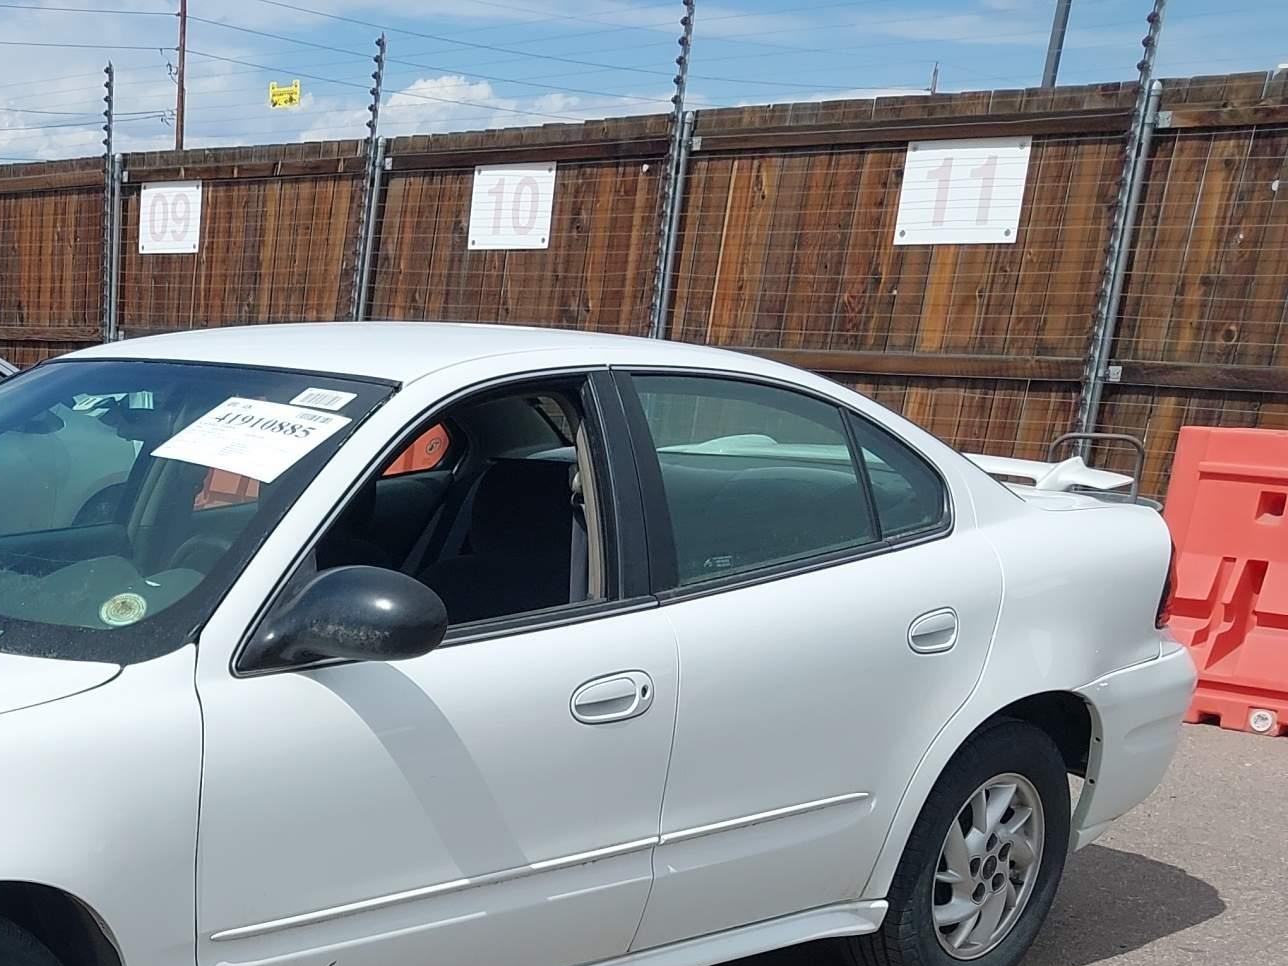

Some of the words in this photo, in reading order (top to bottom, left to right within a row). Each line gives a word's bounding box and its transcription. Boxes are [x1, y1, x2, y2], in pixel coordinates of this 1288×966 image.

[150, 192, 191, 242] 09
[487, 176, 540, 236] 10
[925, 156, 998, 227] 11
[215, 411, 317, 439] 41910885
